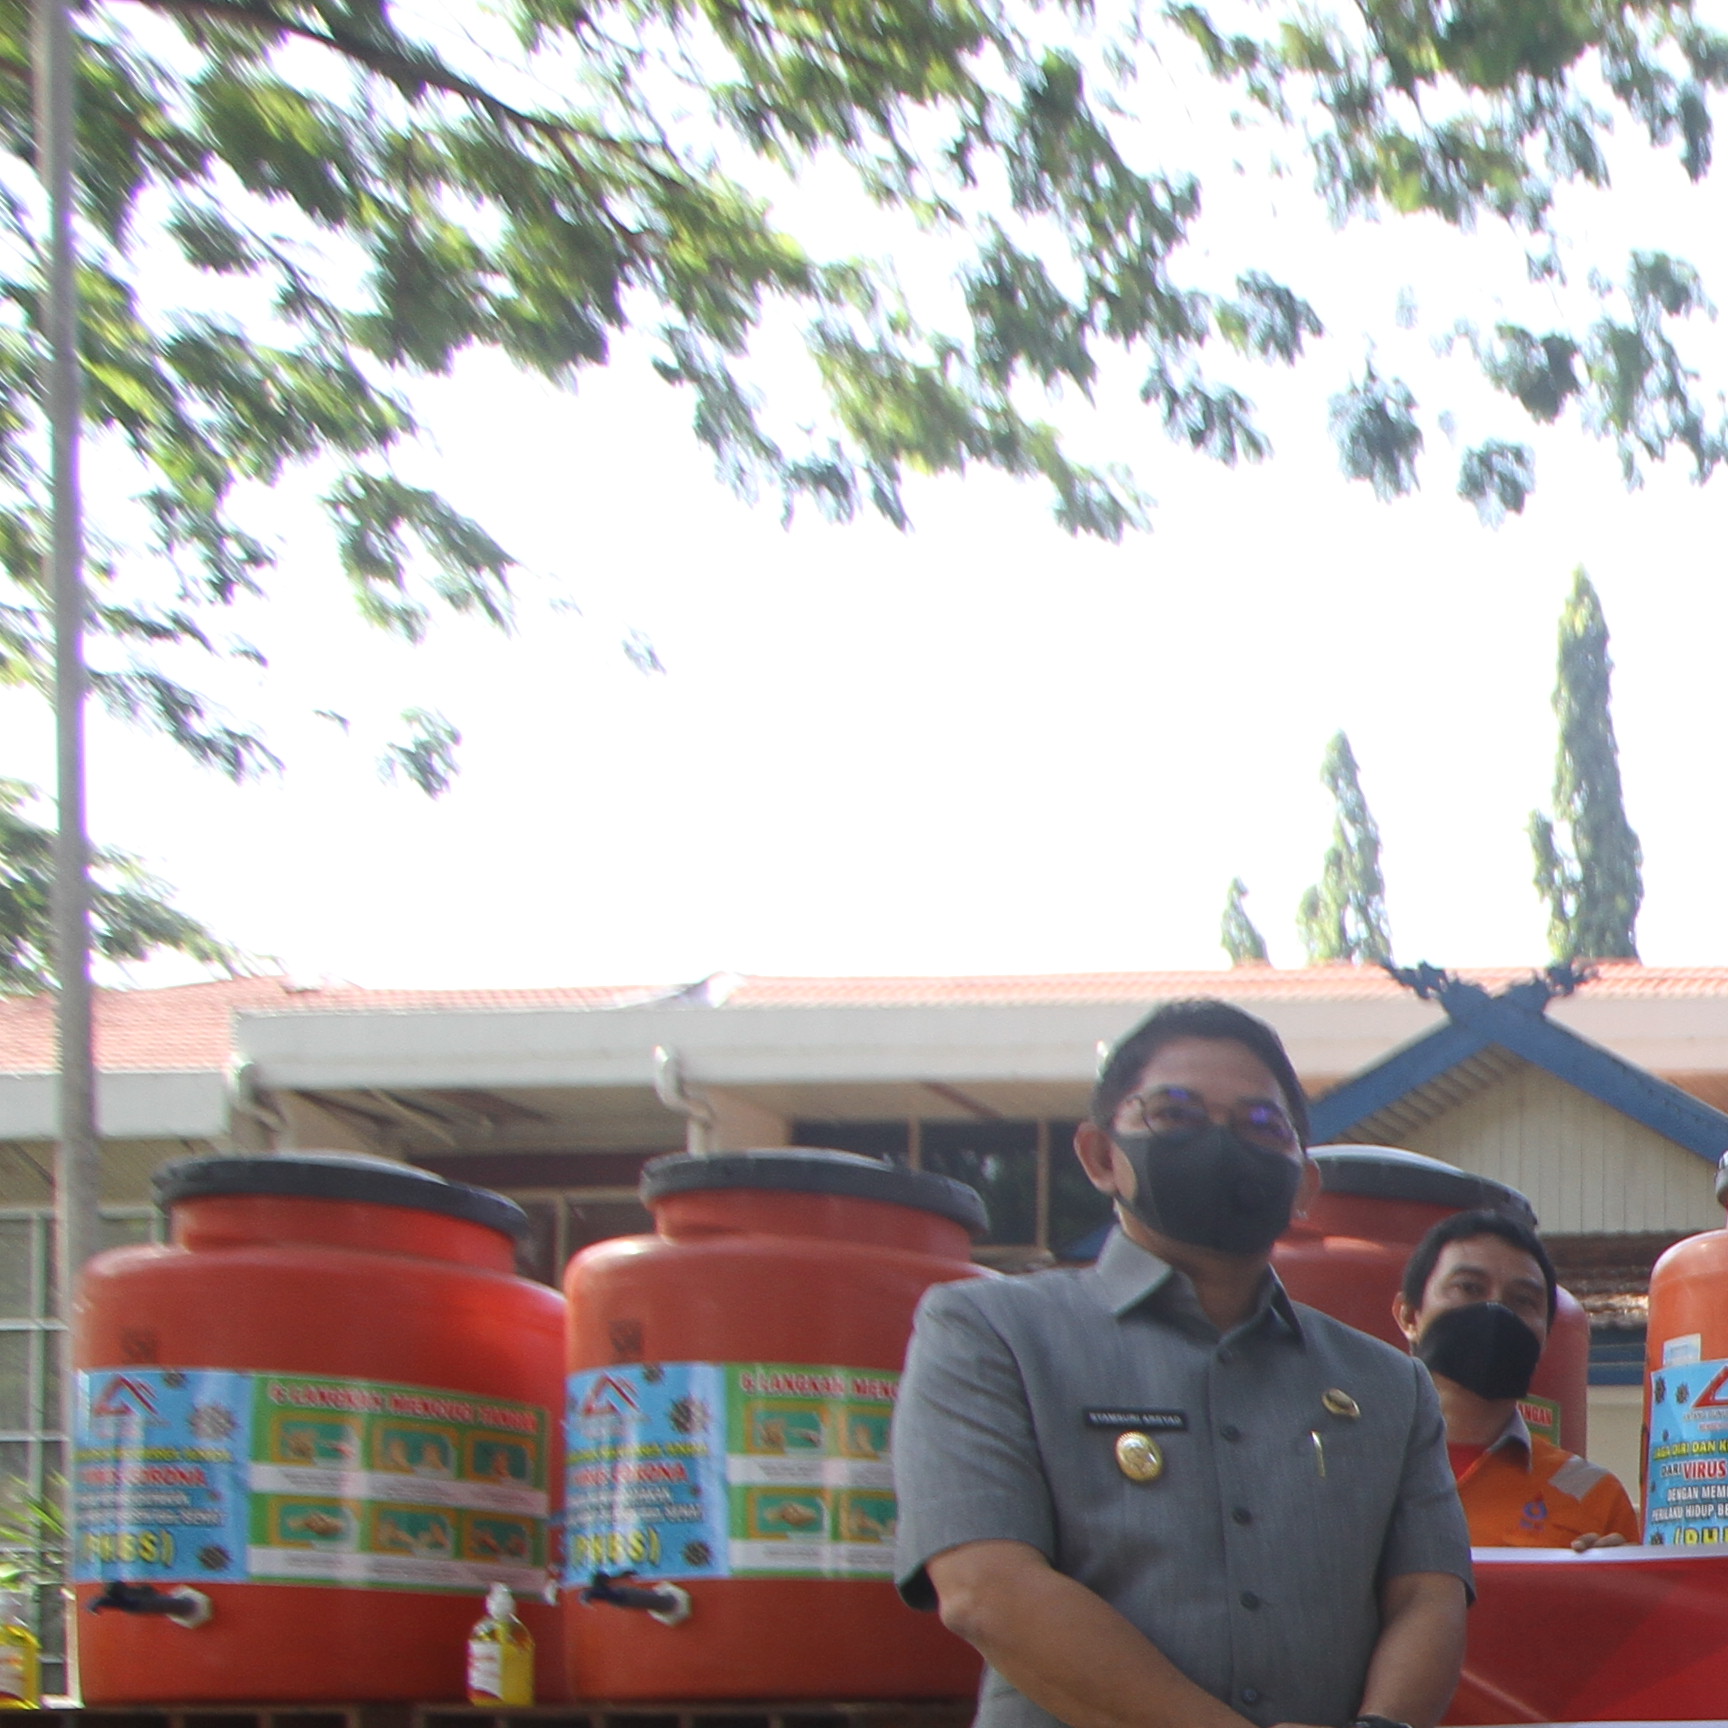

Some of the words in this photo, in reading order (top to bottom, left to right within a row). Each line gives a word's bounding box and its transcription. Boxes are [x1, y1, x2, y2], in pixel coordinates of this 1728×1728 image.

[1692, 1440, 1717, 1455] DAN
[1661, 1463, 1682, 1477] DARI
[1683, 1458, 1727, 1480] VIRUS
[1667, 1487, 1699, 1502] DENGAN
[1685, 1503, 1715, 1519] HIDUP
